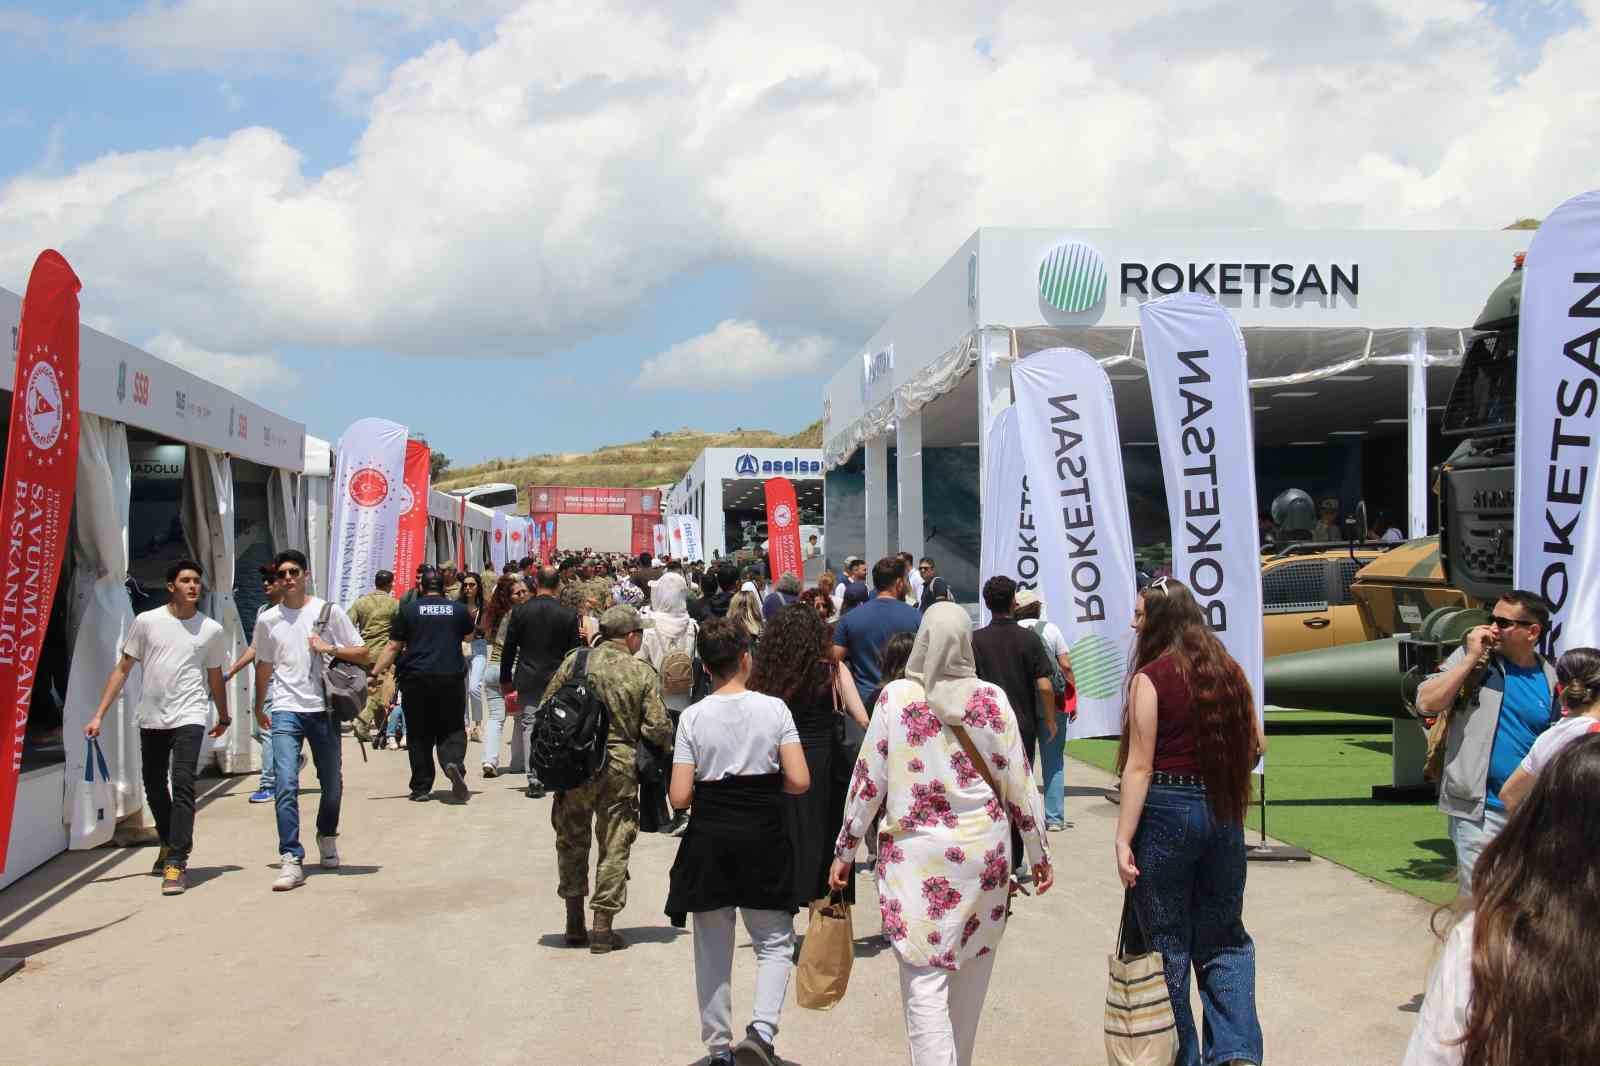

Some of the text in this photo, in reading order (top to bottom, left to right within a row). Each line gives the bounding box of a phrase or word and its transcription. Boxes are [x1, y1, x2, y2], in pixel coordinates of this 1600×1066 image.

[1120, 262, 1359, 295] ROKETSAN
[21, 482, 44, 638] SAVUNMA
[420, 604, 453, 616] PRESS
